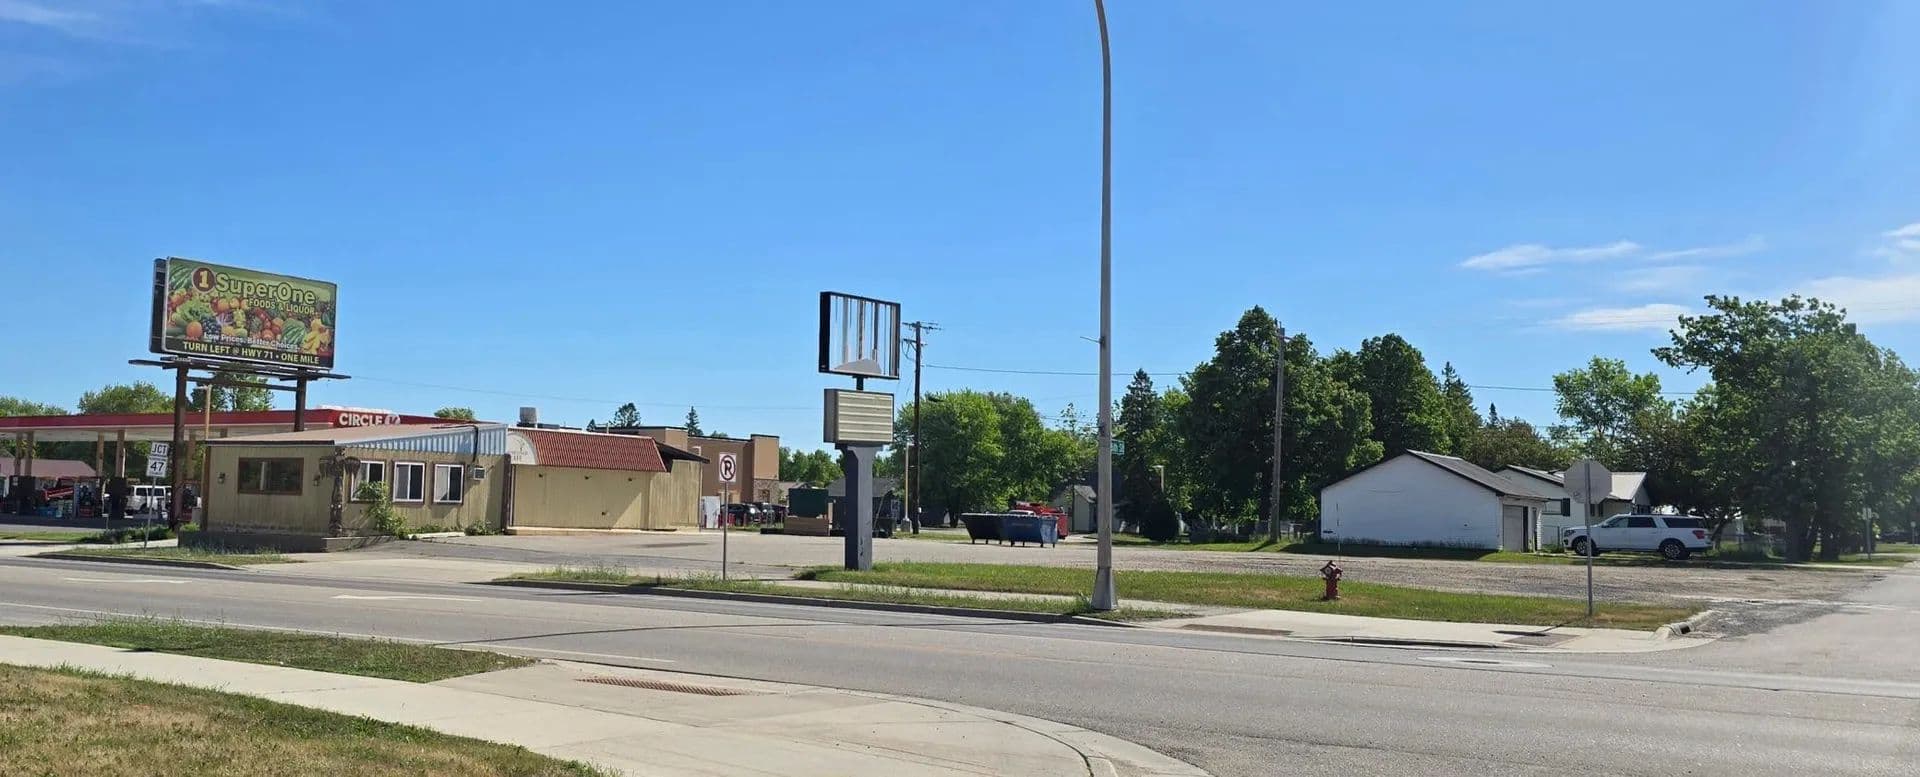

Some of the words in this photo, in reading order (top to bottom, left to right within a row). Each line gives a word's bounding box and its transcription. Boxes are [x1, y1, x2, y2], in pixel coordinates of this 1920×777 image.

[215, 272, 316, 305] SuperOne
[249, 298, 275, 308] FOODS
[286, 303, 315, 315] LIQUOR
[204, 332, 217, 341] Low
[247, 337, 270, 347] Better
[183, 341, 207, 352] TURN
[210, 344, 230, 354] LEFT
[241, 347, 262, 358] HWY
[264, 351, 273, 359] 71
[281, 353, 298, 362] ONE
[300, 354, 320, 364] MILE
[339, 412, 383, 426] CIRCLE
[152, 444, 166, 454] JCT
[150, 461, 164, 472] 47
